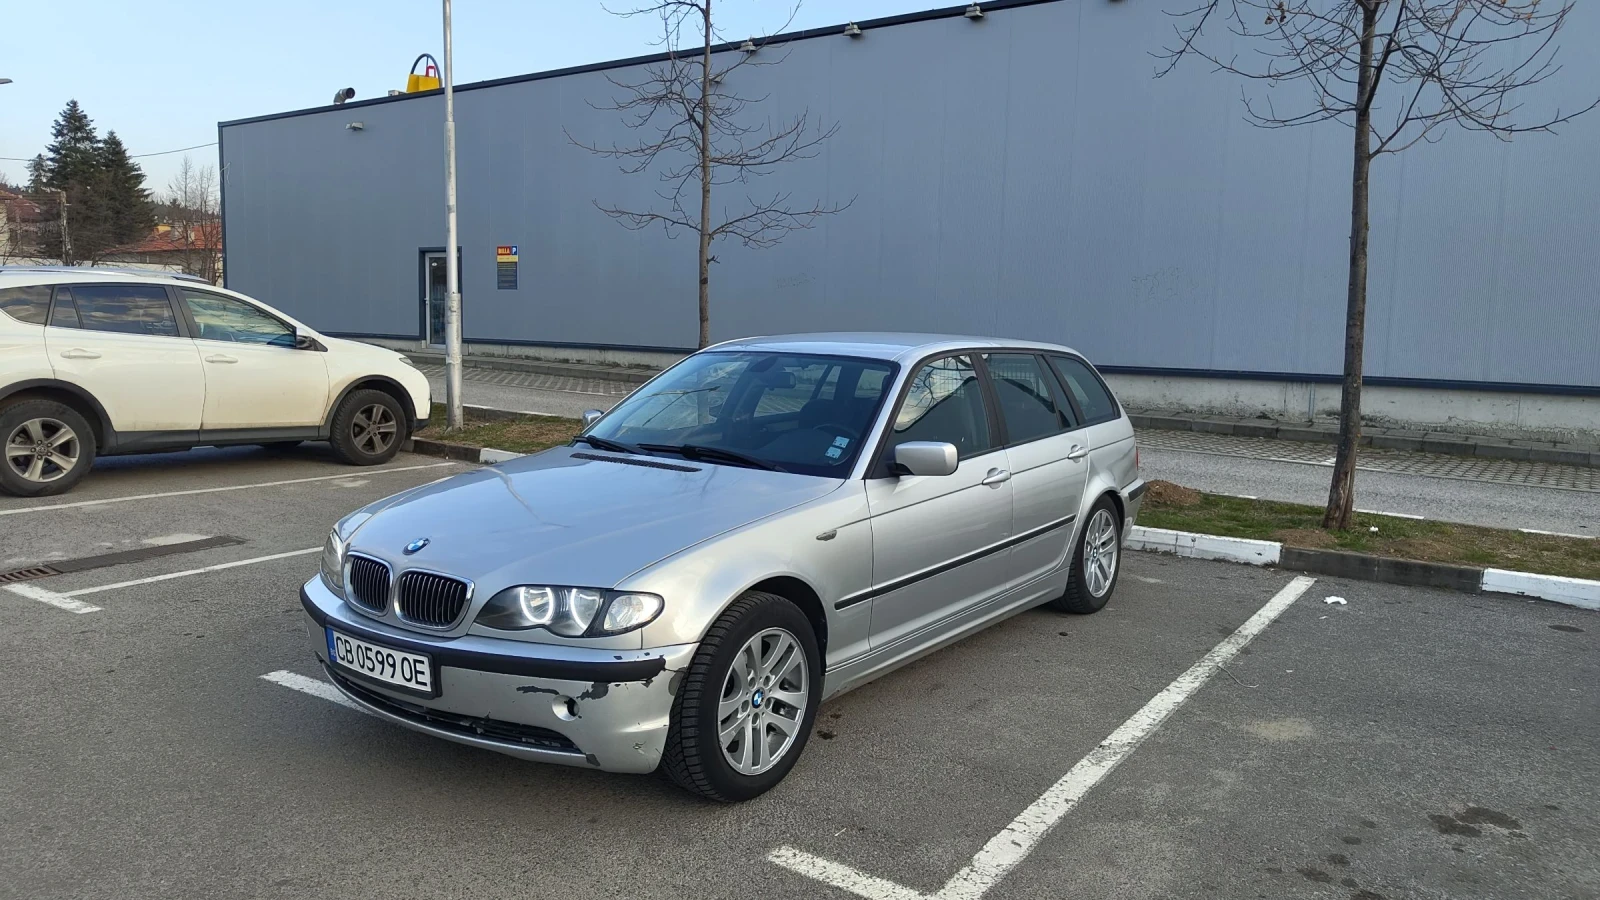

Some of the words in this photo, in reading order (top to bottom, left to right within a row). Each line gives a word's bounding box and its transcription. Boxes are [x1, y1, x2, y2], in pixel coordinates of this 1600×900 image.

[335, 636, 354, 664] CB
[357, 644, 396, 678] 0599
[401, 657, 428, 686] OE
